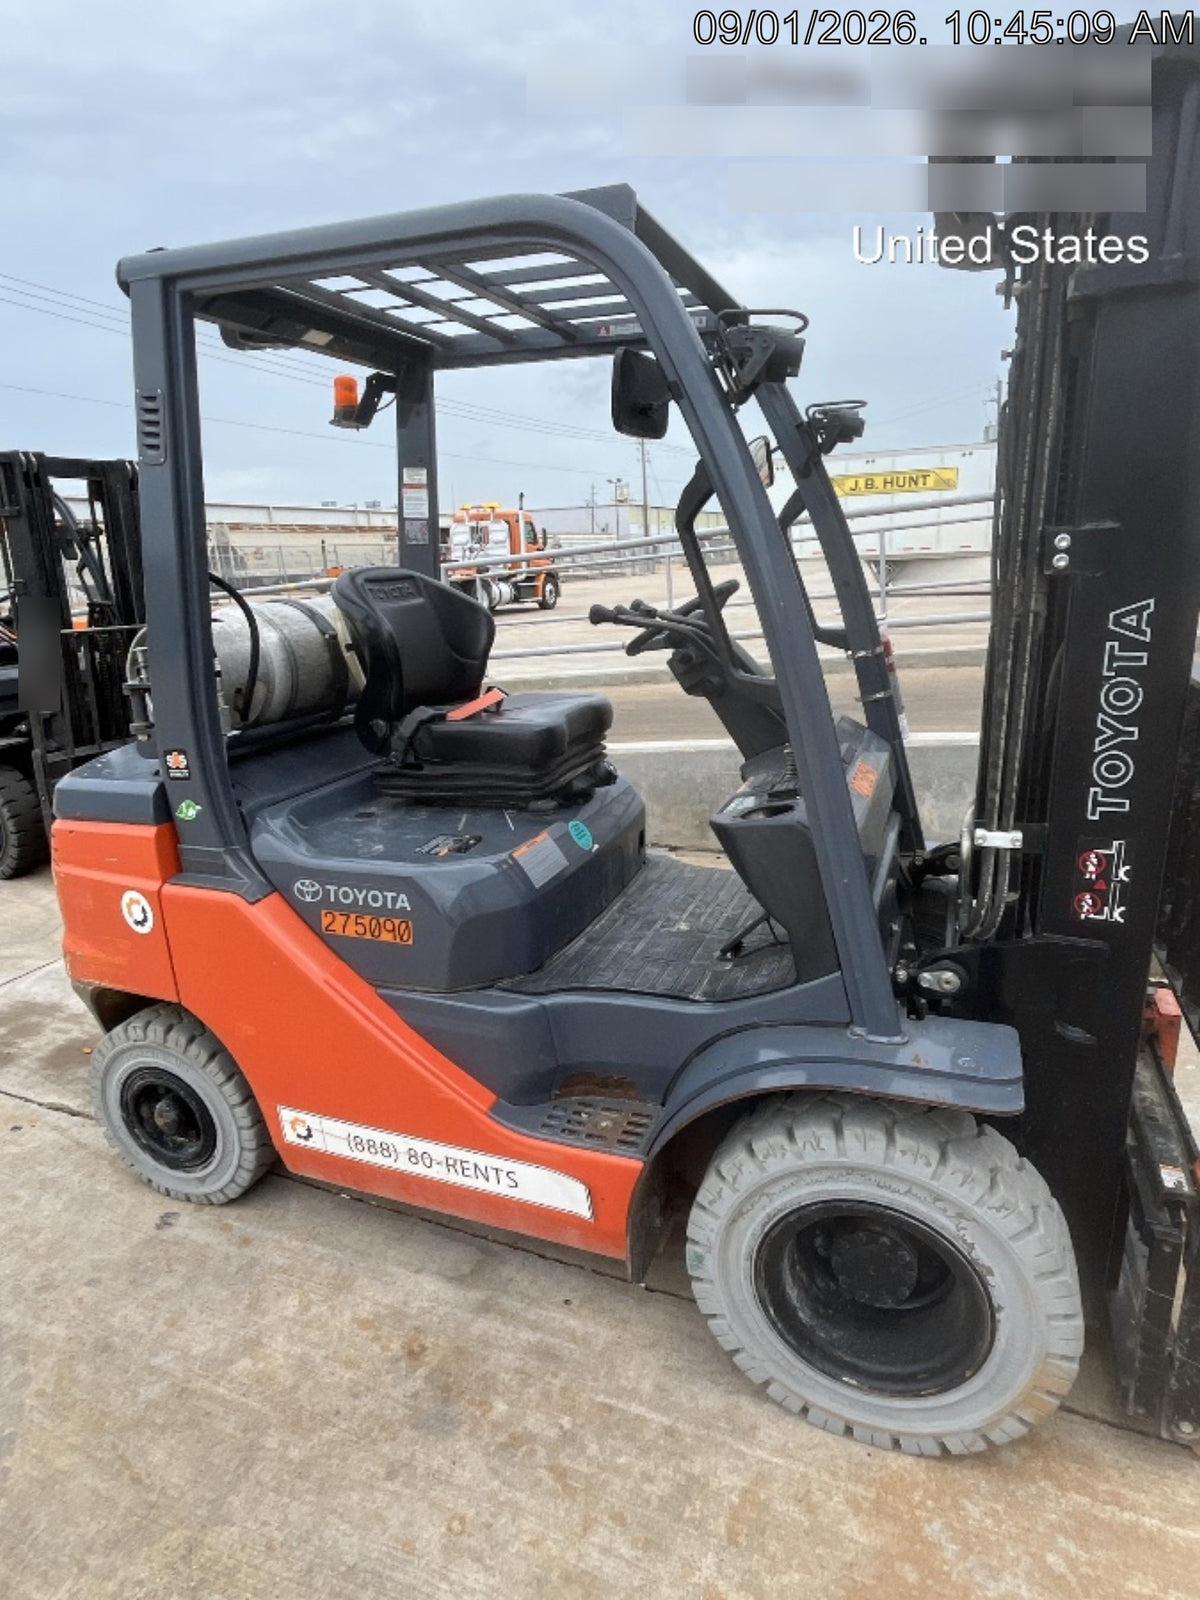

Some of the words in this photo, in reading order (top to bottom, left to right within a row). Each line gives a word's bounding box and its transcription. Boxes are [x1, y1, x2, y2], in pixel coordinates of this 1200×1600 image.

[883, 474, 930, 490] HUNT
[367, 583, 416, 600] TOYOTA
[1087, 598, 1155, 820] TOYOTA
[324, 884, 411, 911] TOYOTA
[324, 911, 411, 943] 275090
[346, 1134, 399, 1163] (888)
[407, 1147, 519, 1189] 80-RENTS
